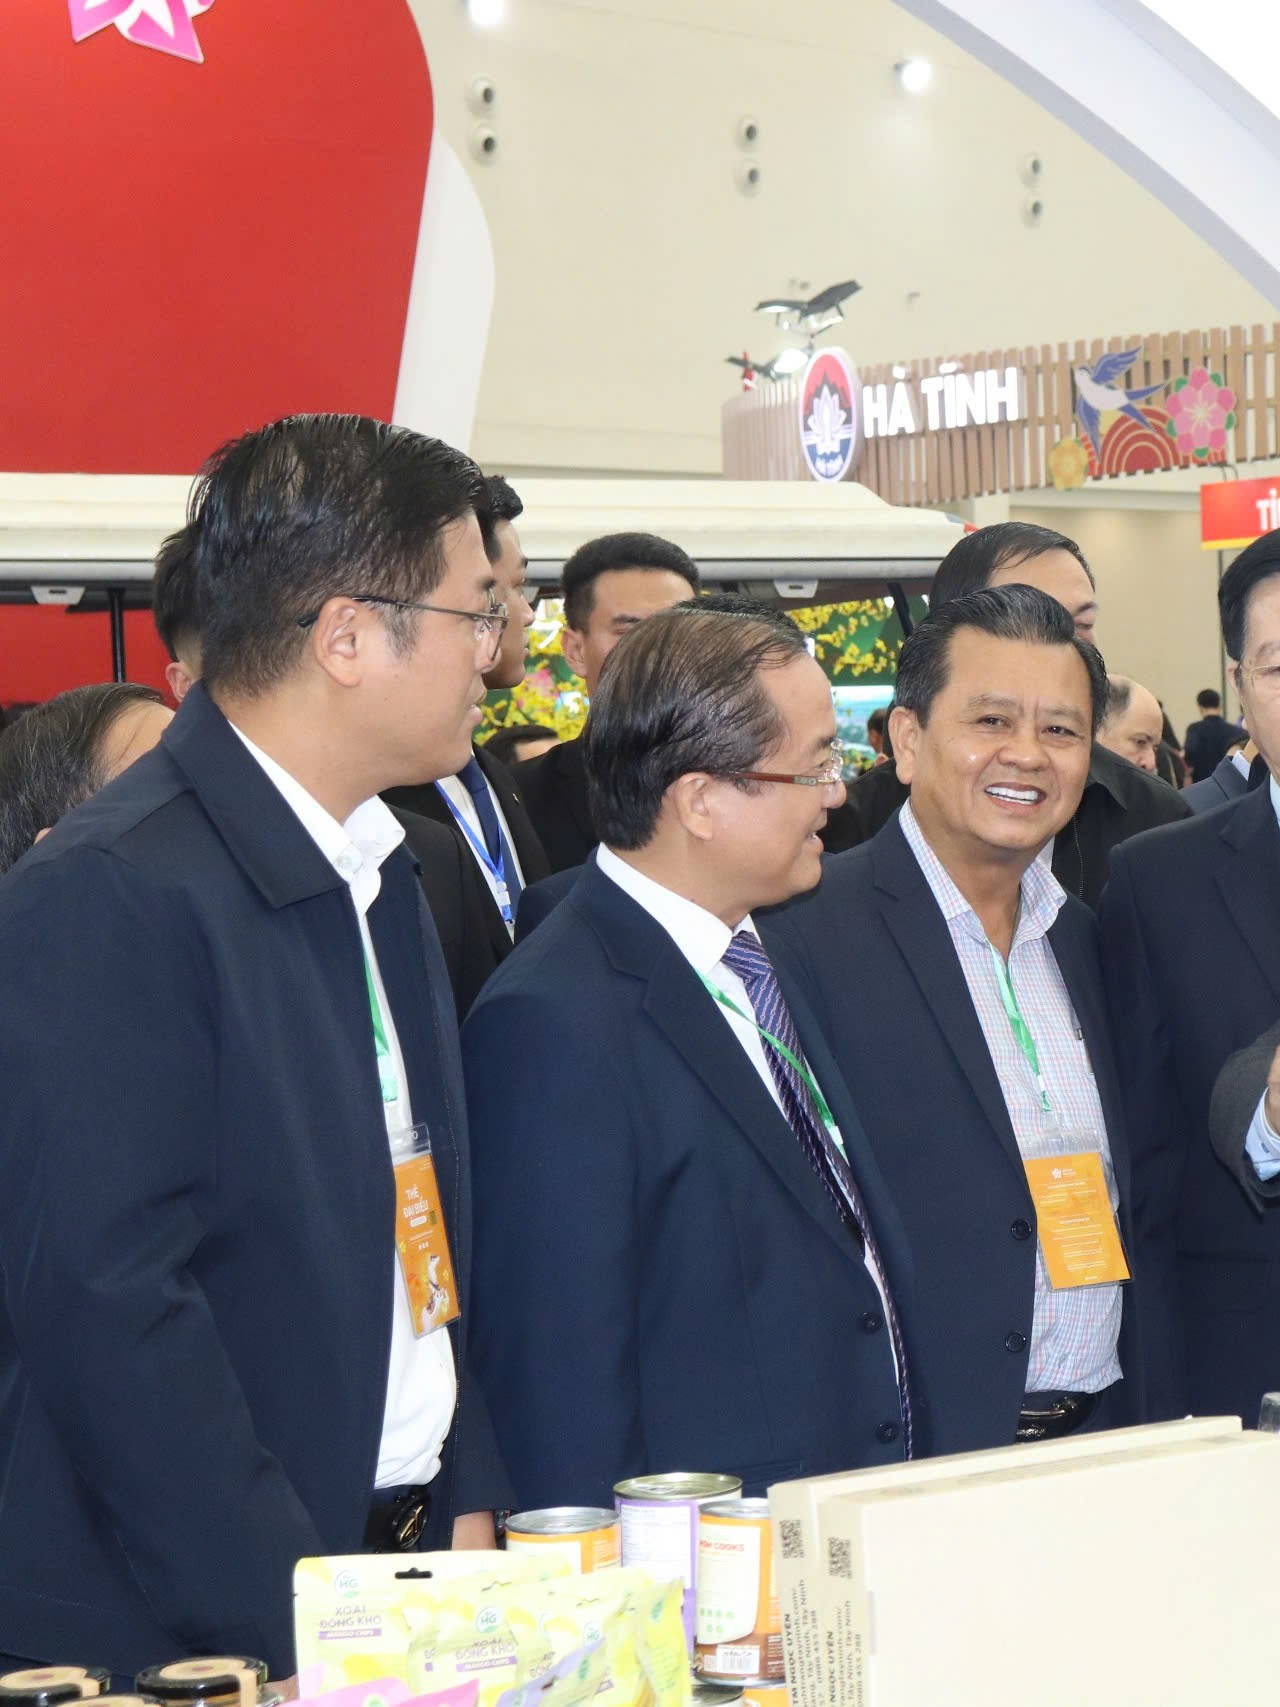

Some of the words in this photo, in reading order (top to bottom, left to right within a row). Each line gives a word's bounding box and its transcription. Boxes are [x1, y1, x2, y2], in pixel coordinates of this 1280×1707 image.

[862, 366, 916, 438] HÀ
[921, 362, 1019, 431] TĨNH
[339, 1578, 359, 1588] HG
[480, 1614, 497, 1624] HG
[784, 1613, 793, 1646] UYÊN
[787, 1649, 798, 1684] NGỌC
[792, 1688, 799, 1704] TM
